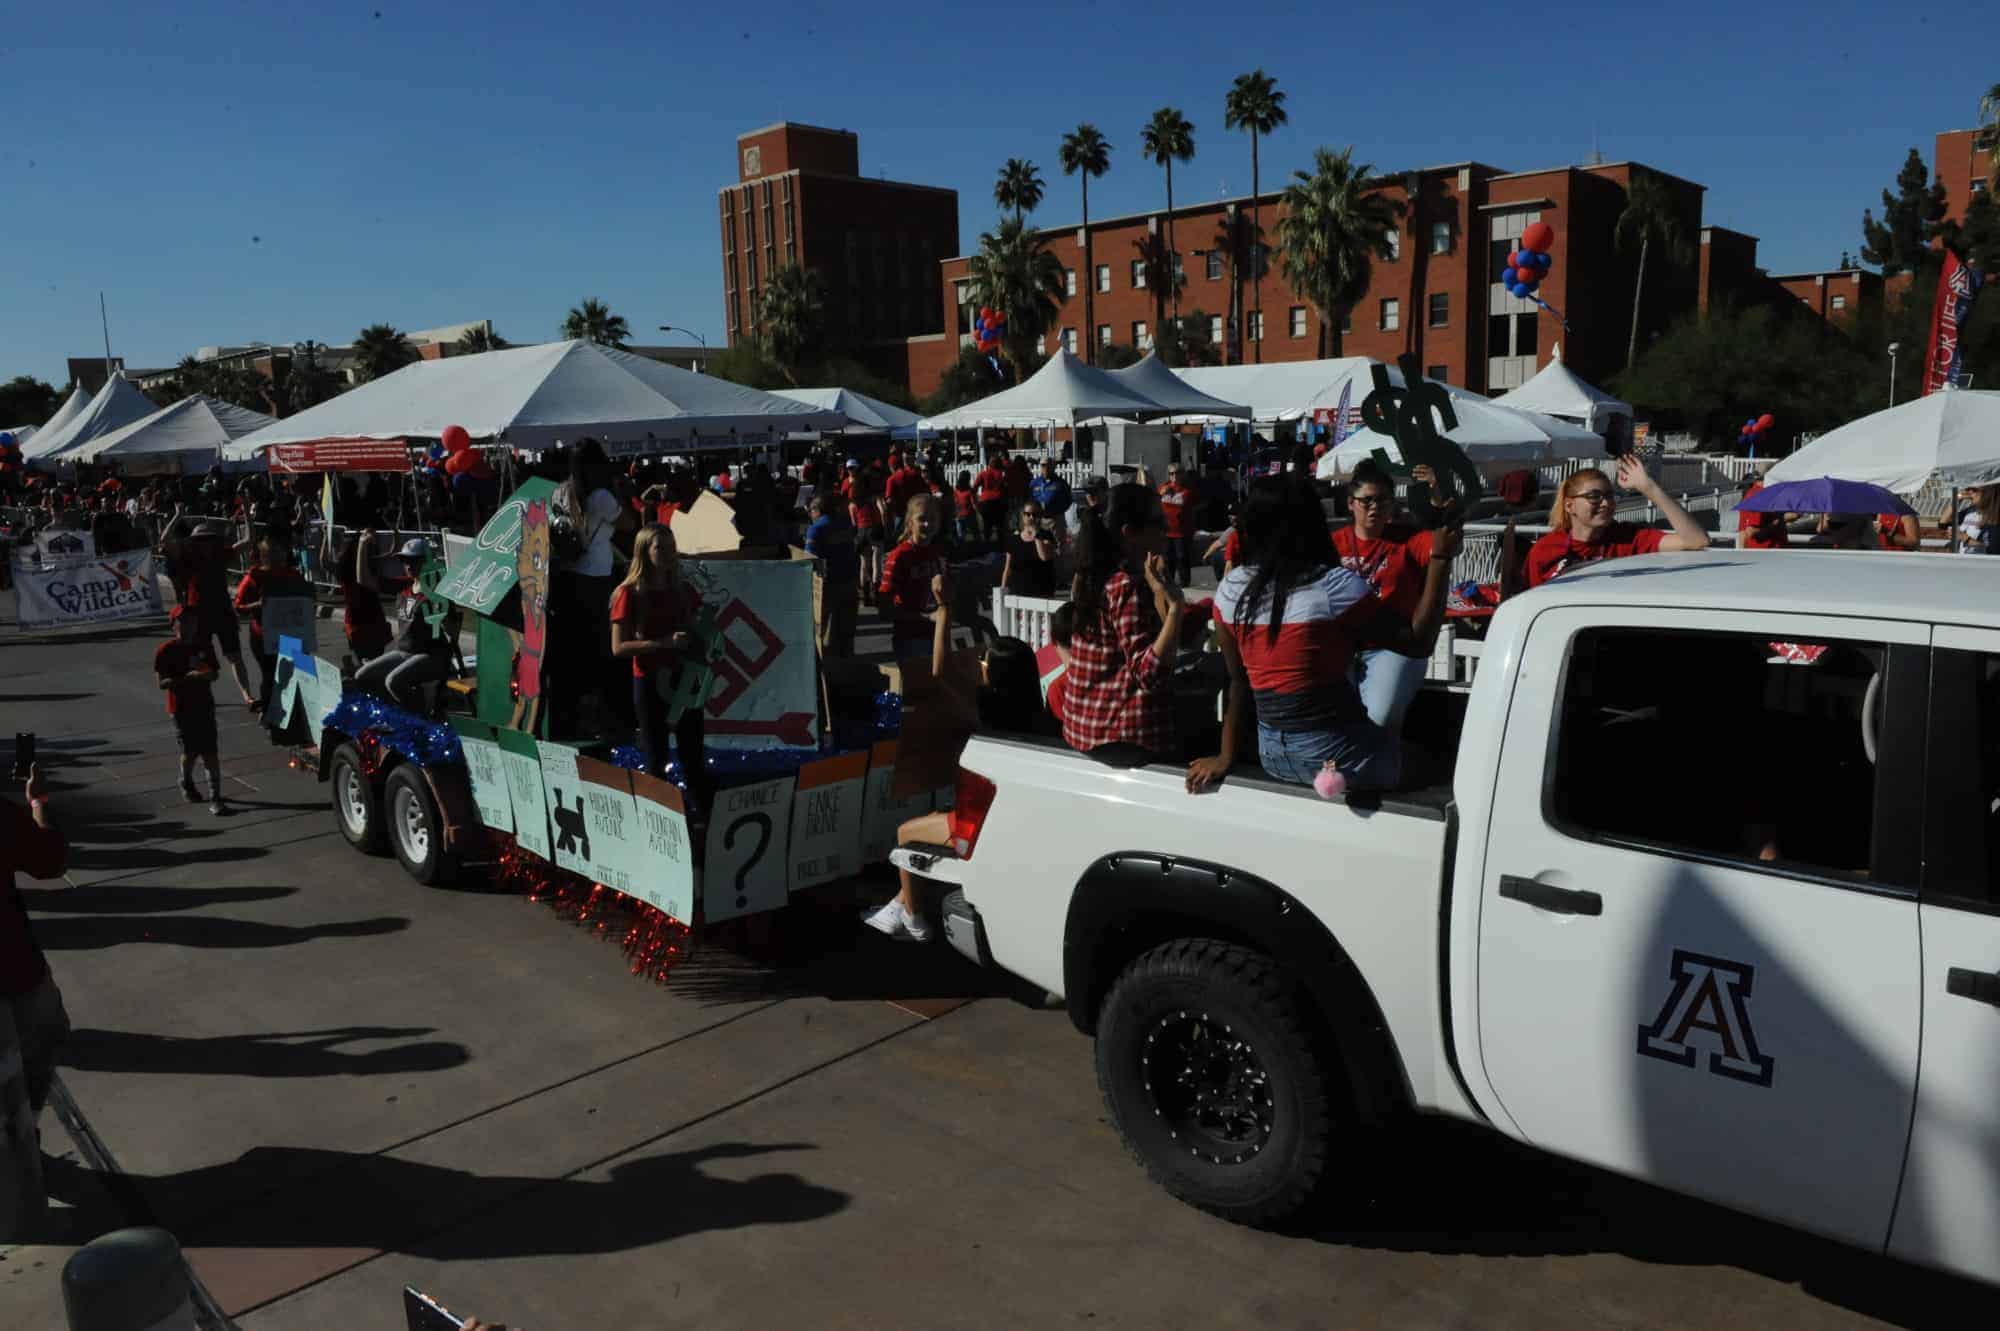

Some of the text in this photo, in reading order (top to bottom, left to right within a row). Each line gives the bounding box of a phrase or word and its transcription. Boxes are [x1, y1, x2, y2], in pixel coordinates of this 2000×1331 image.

[46, 578, 120, 600] Camp
[55, 588, 152, 614] Wildcat
[1637, 948, 1775, 1088] A
